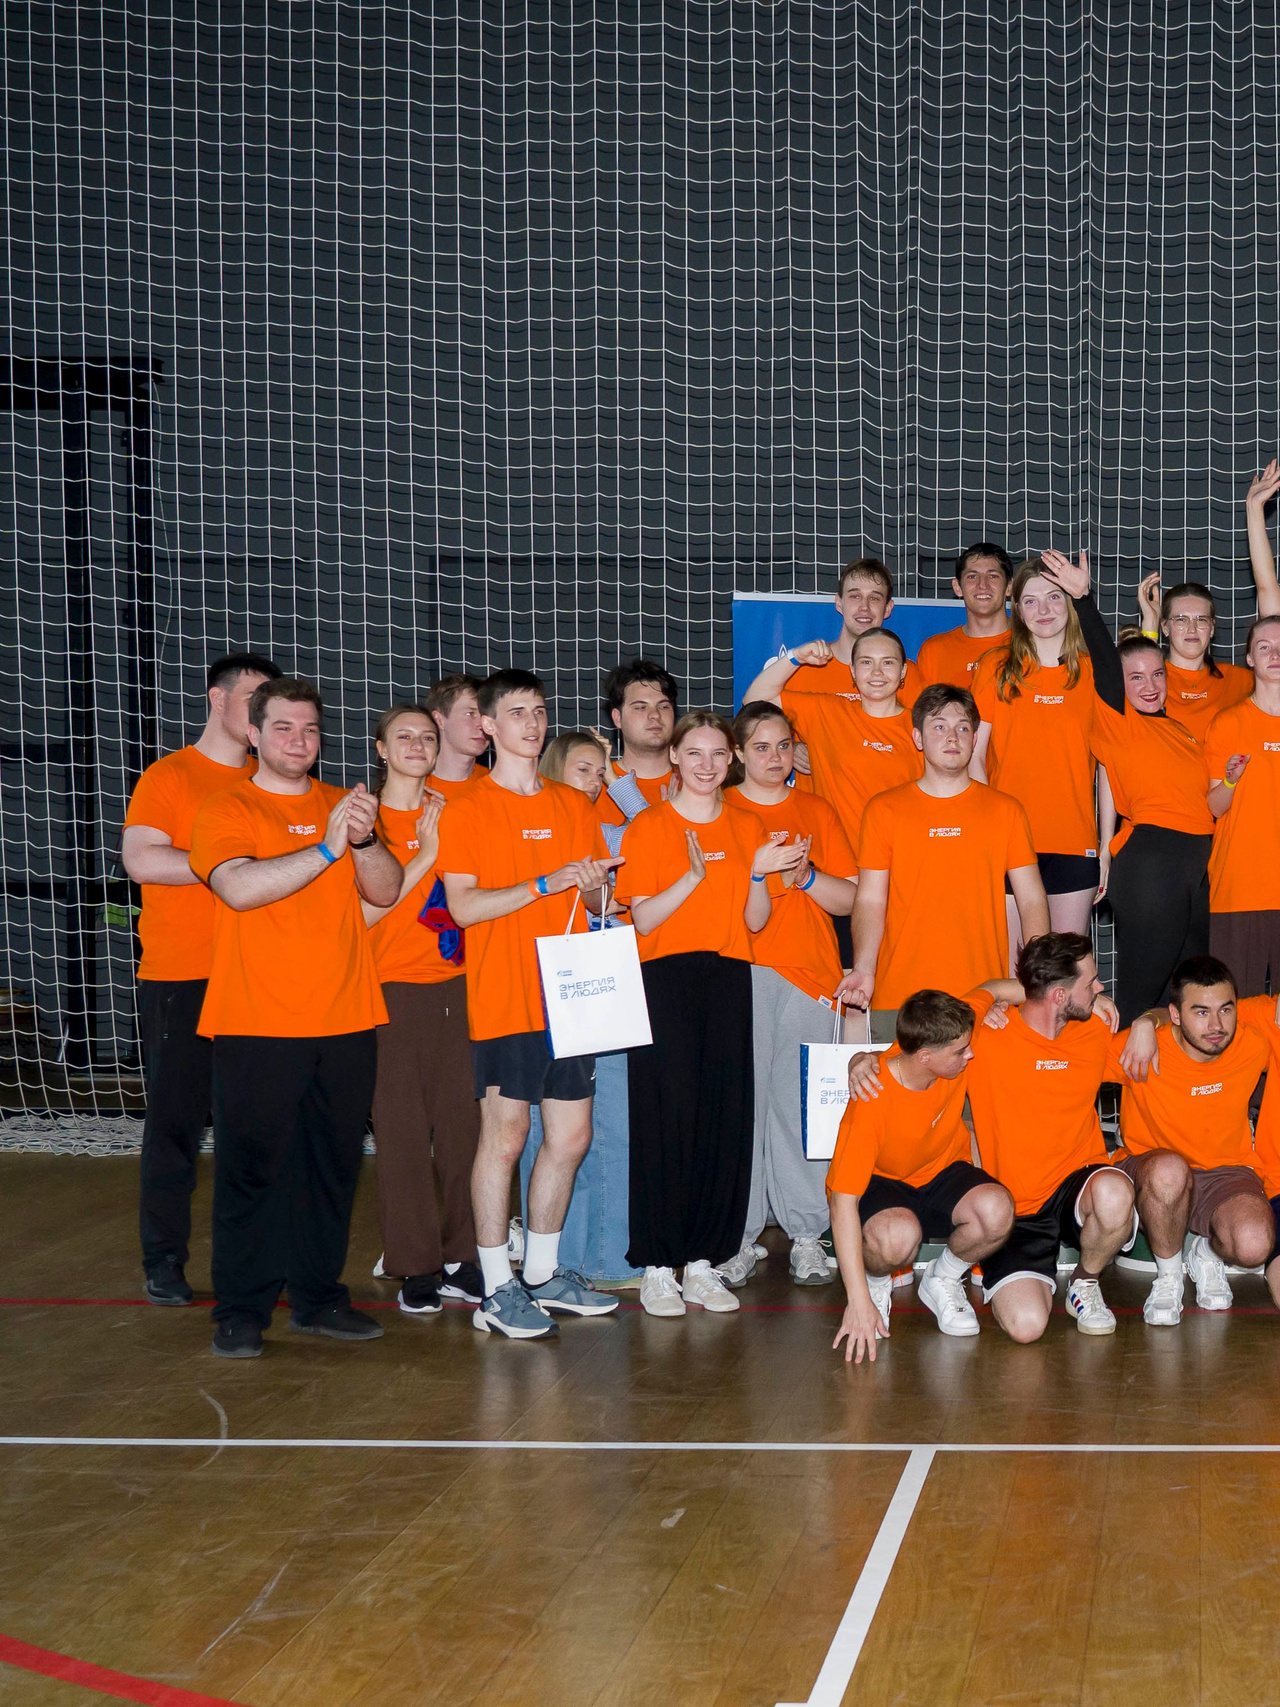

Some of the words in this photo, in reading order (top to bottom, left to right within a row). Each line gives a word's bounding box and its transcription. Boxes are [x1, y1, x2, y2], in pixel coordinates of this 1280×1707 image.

[559, 977, 615, 991] ЭНЕРГИЯ
[560, 992, 568, 1000] В
[571, 985, 616, 998] ЛЮДЯХ
